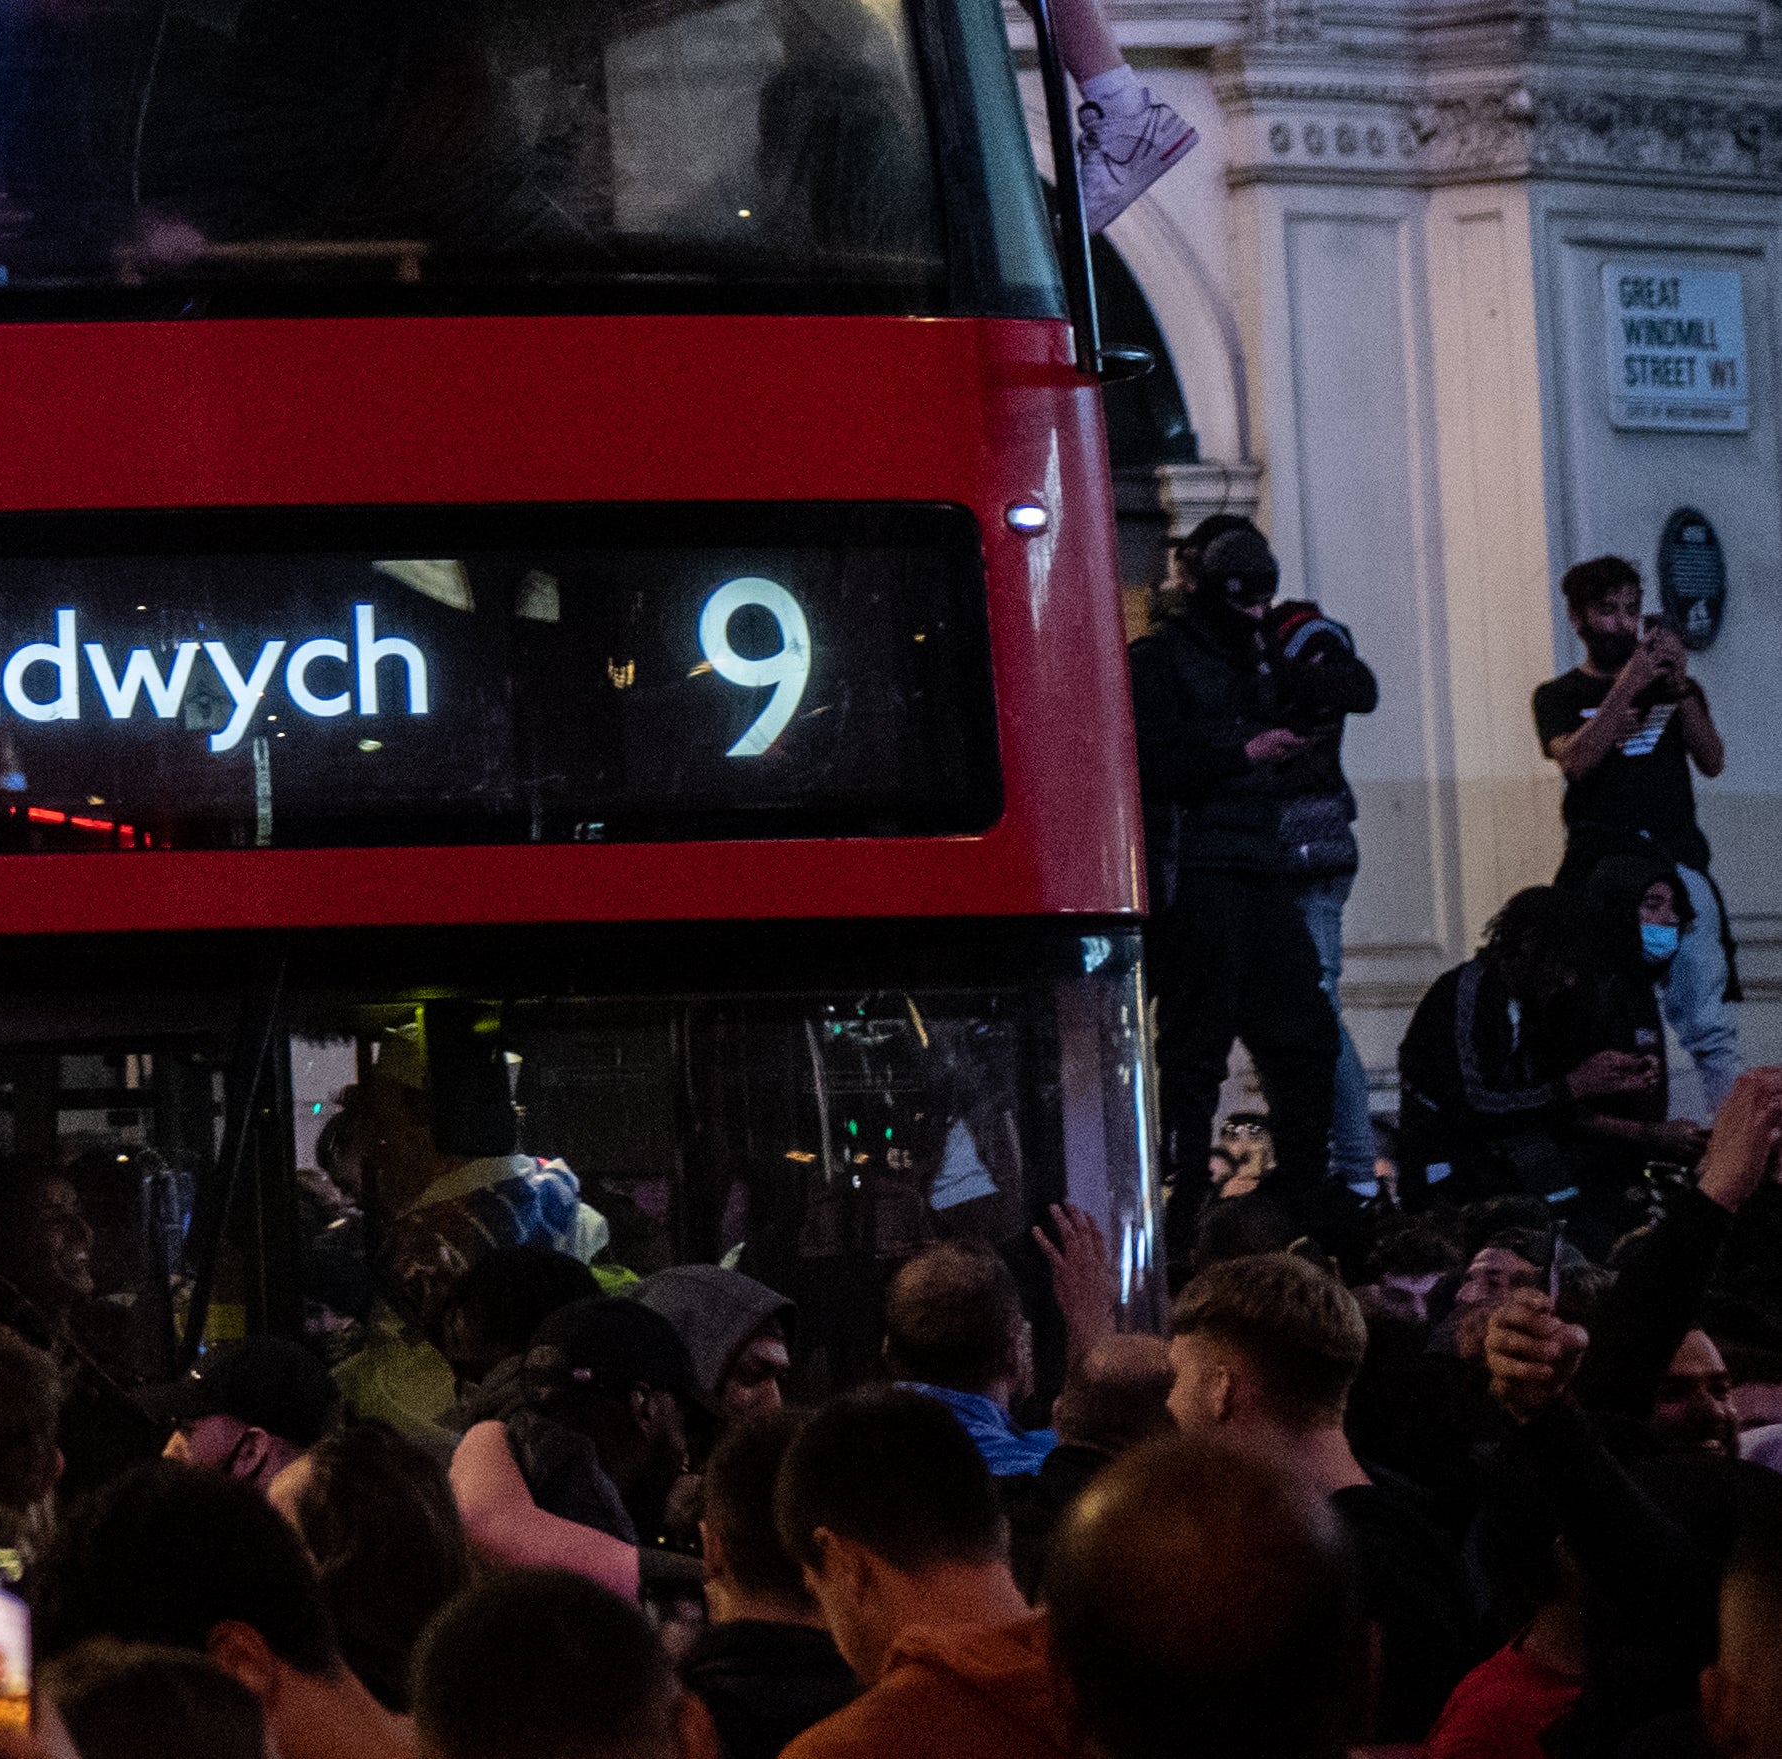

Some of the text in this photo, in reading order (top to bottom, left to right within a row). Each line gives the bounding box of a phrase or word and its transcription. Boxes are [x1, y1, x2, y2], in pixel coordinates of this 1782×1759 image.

[1619, 276, 1680, 310] GREAT
[1622, 319, 1719, 352] WINDMILL
[1624, 355, 1737, 389] STREET W1
[697, 576, 811, 758] 9
